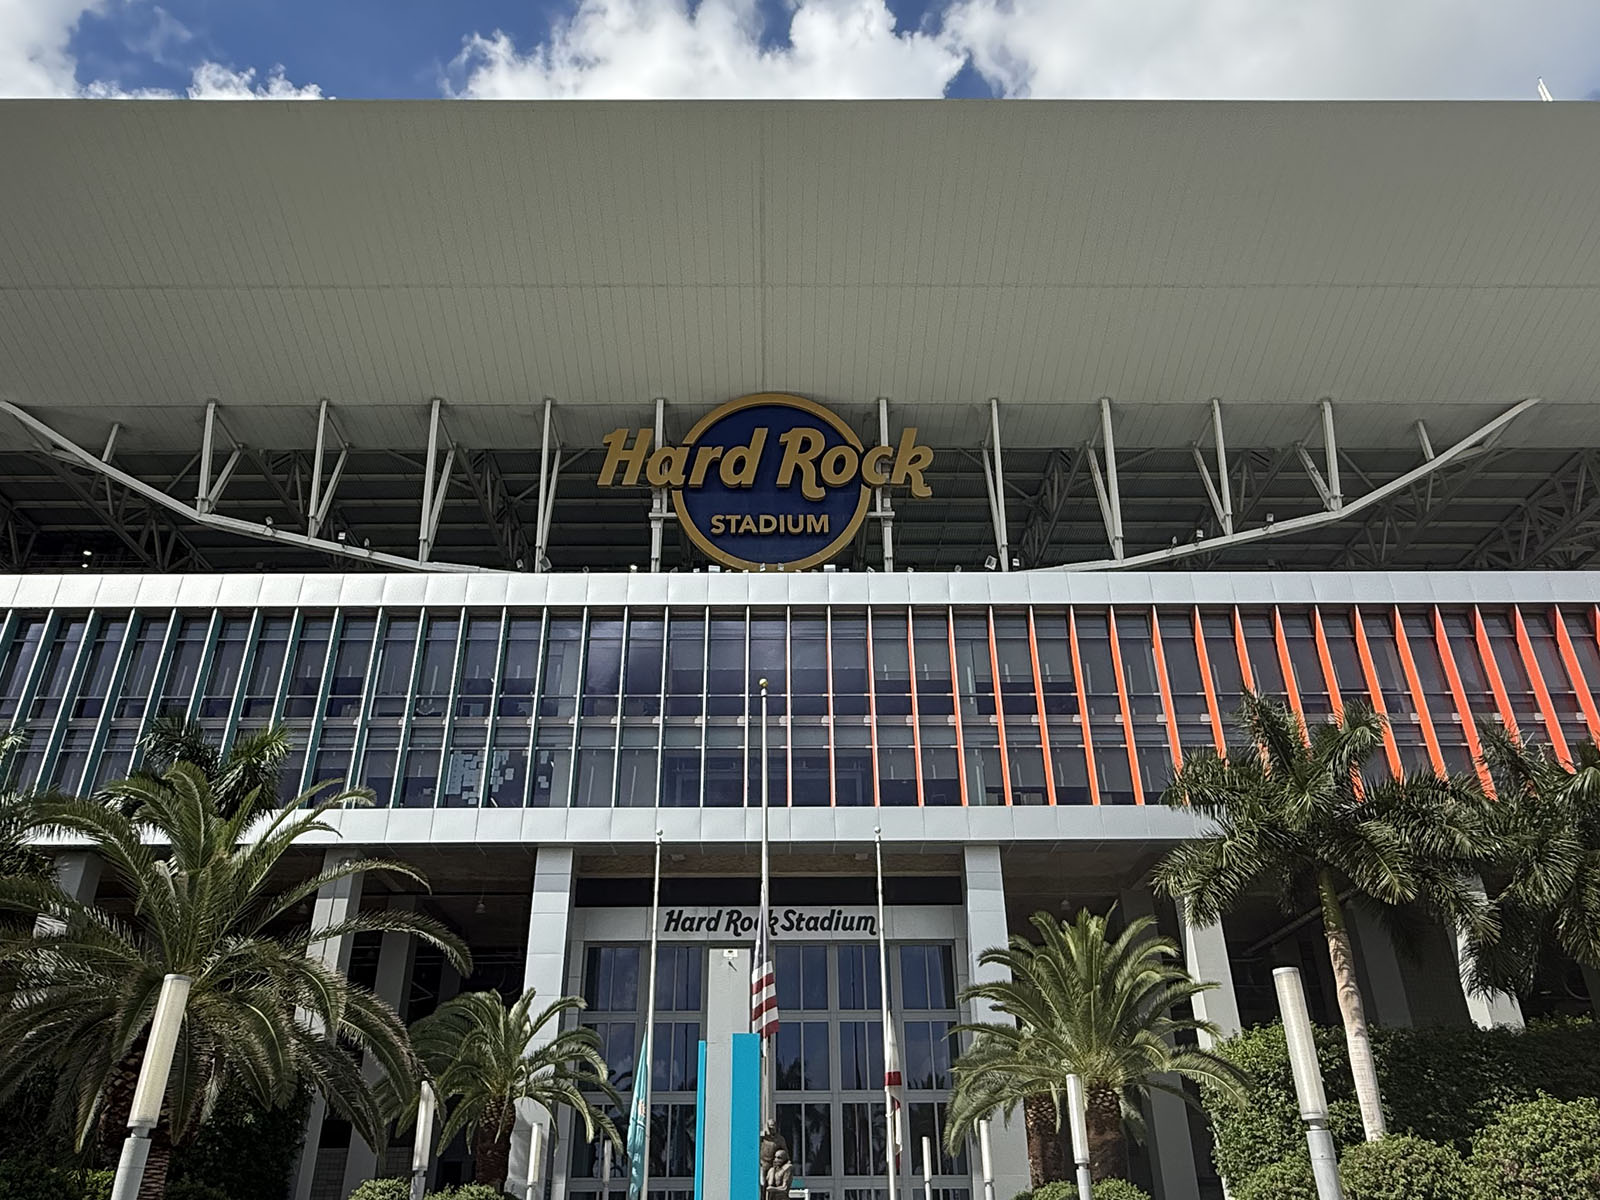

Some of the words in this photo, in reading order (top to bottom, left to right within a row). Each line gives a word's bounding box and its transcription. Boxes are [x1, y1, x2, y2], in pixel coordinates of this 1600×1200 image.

[597, 428, 768, 487] Hard
[776, 428, 934, 500] Rock
[710, 513, 829, 535] STADIUM
[664, 909, 722, 932] Hard
[780, 909, 876, 936] Stadium
